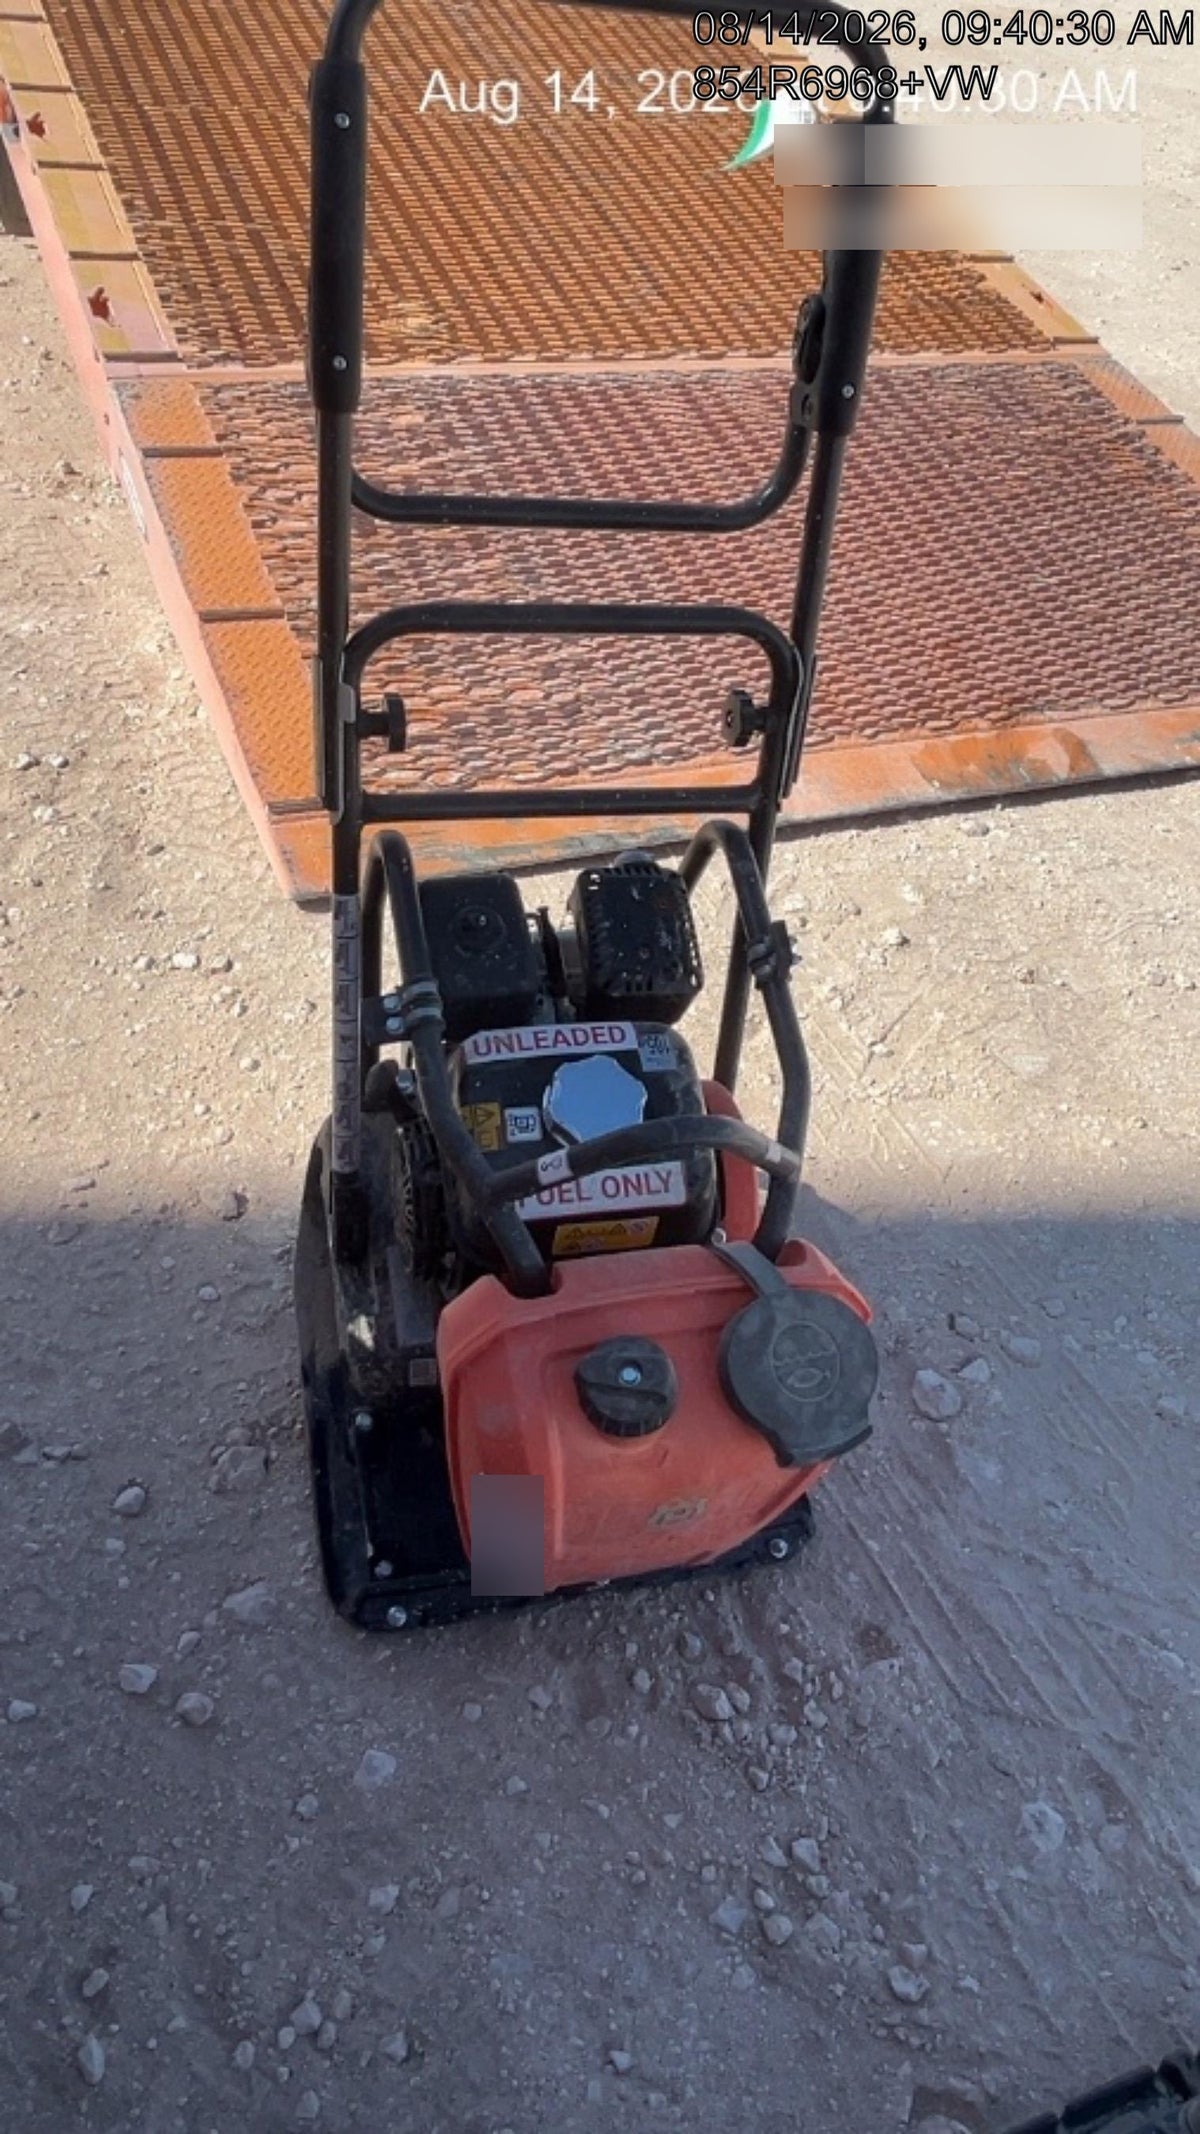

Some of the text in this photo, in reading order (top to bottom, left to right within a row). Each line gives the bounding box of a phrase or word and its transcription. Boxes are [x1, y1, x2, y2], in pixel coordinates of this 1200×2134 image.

[473, 1026, 626, 1056] UNLEADED
[519, 1170, 672, 1207] UEL ONLY
